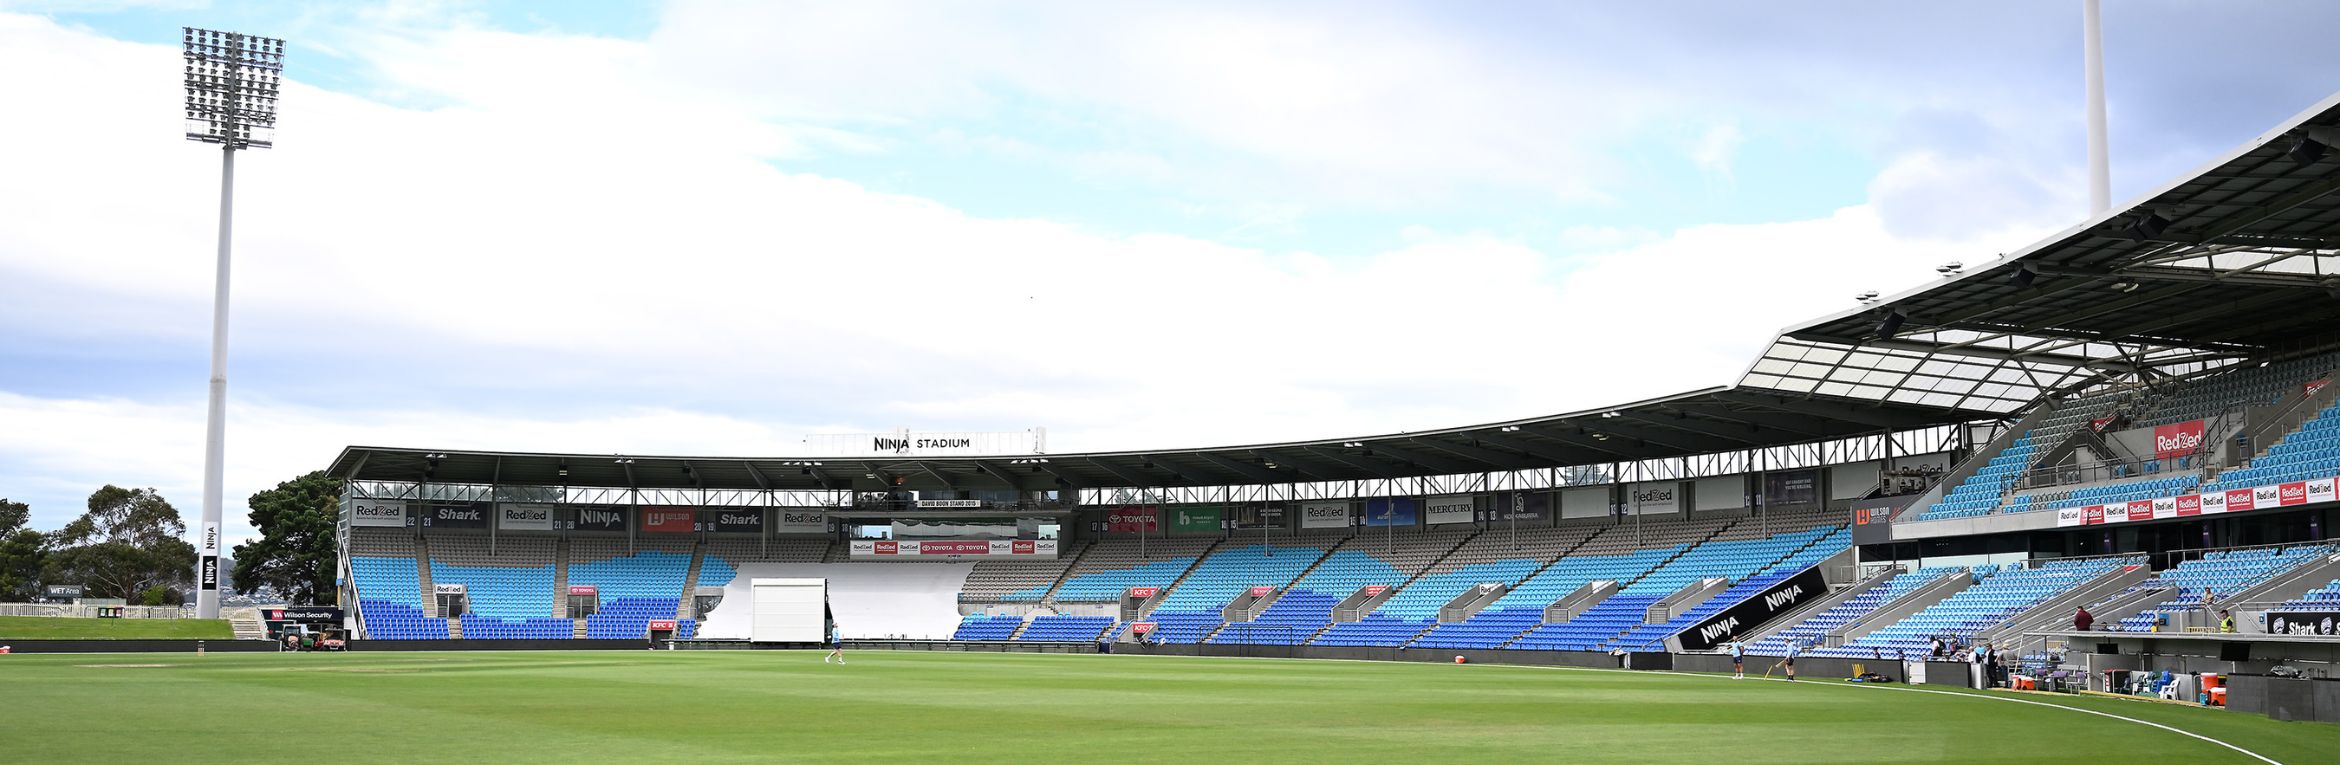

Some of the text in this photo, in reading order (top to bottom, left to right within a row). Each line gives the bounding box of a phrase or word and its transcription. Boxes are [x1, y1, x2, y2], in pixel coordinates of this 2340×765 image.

[874, 437, 970, 453] NINJA STADIUM
[2157, 430, 2202, 451] RedZed
[2309, 484, 2331, 494] RedZed
[356, 505, 399, 516] RedZed
[506, 509, 547, 520] RedZed
[1307, 506, 1344, 517] RedZed
[1428, 504, 1472, 514] MERCURY
[407, 517, 415, 526] 22
[424, 517, 431, 526] 21
[580, 509, 621, 527] NINJA
[784, 513, 822, 523] RedZed
[1122, 515, 1156, 523] TOYOTA
[205, 526, 216, 549] NINJA
[204, 560, 216, 583] NINJA
[1765, 584, 1803, 612] NINJA
[1700, 616, 1740, 644] NINJA
